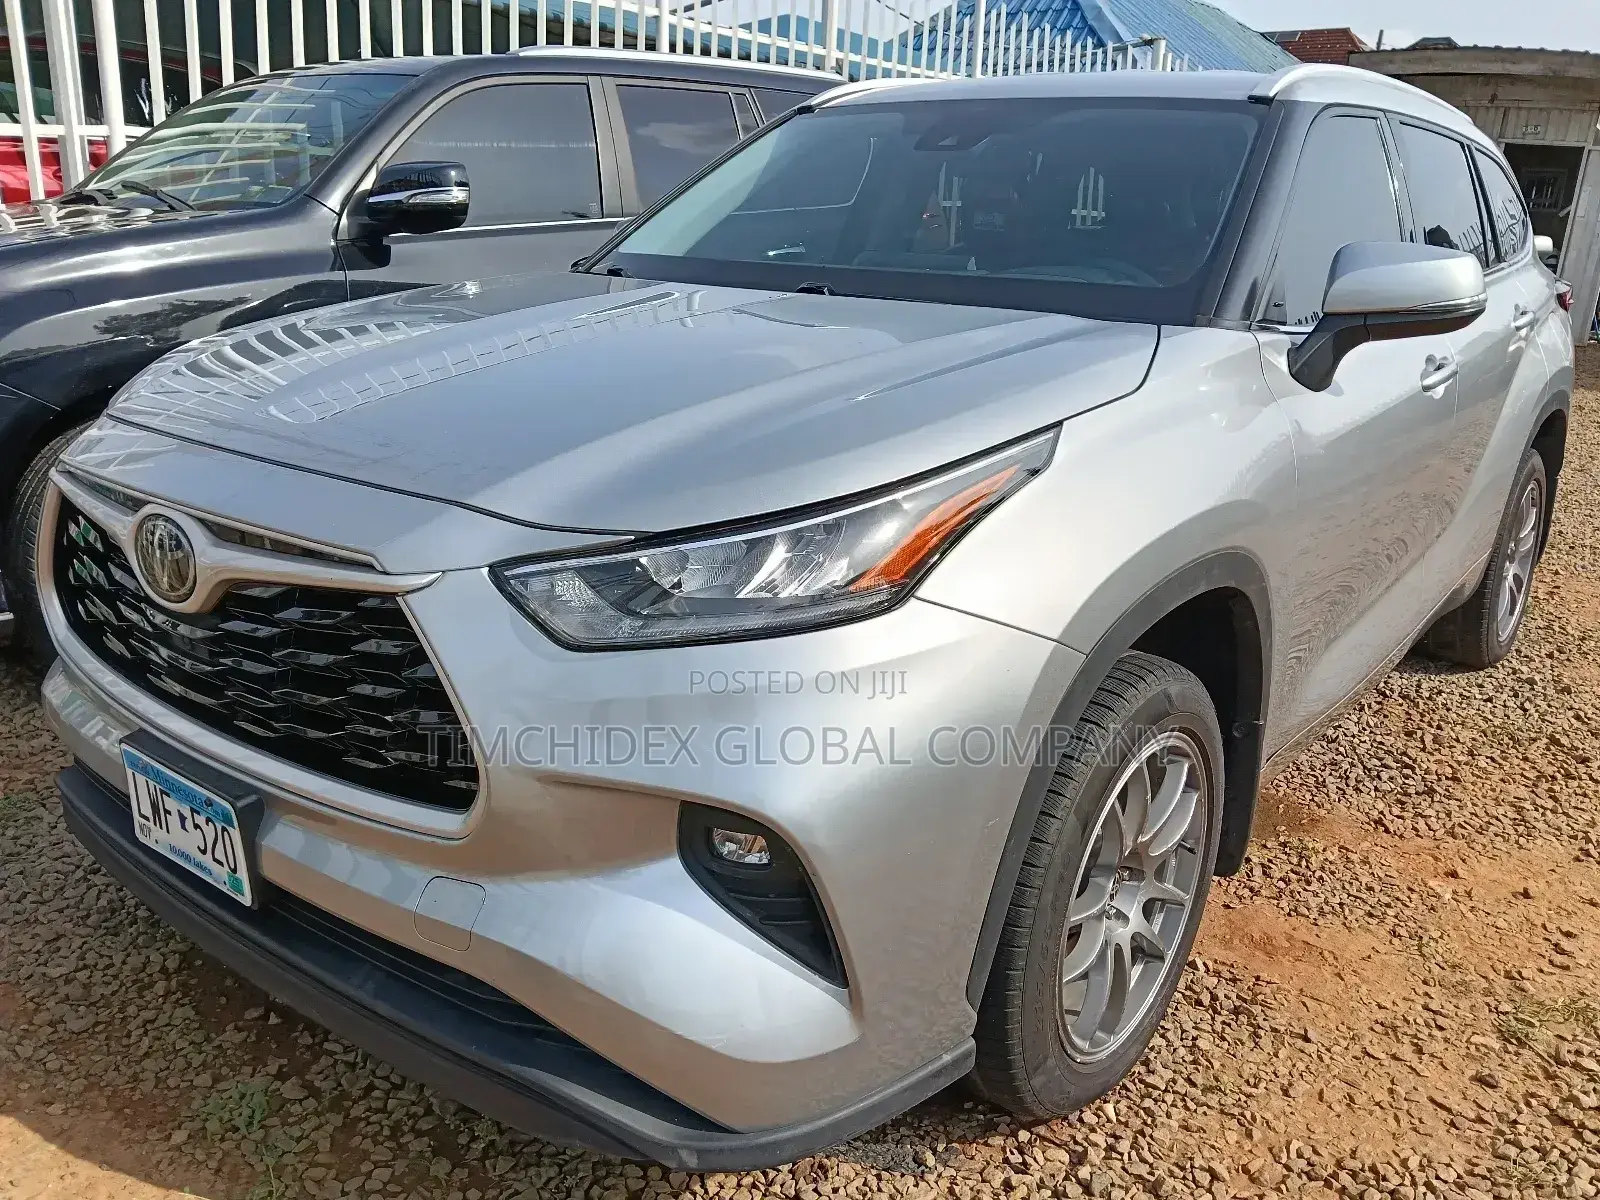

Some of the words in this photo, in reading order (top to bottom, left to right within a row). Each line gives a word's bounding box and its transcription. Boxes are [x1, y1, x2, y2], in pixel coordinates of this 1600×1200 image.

[150, 765, 205, 808] Minnesota
[132, 772, 172, 834] LWF
[189, 806, 238, 875] 520
[169, 843, 191, 863] 10,000
[192, 857, 212, 876] lakes
